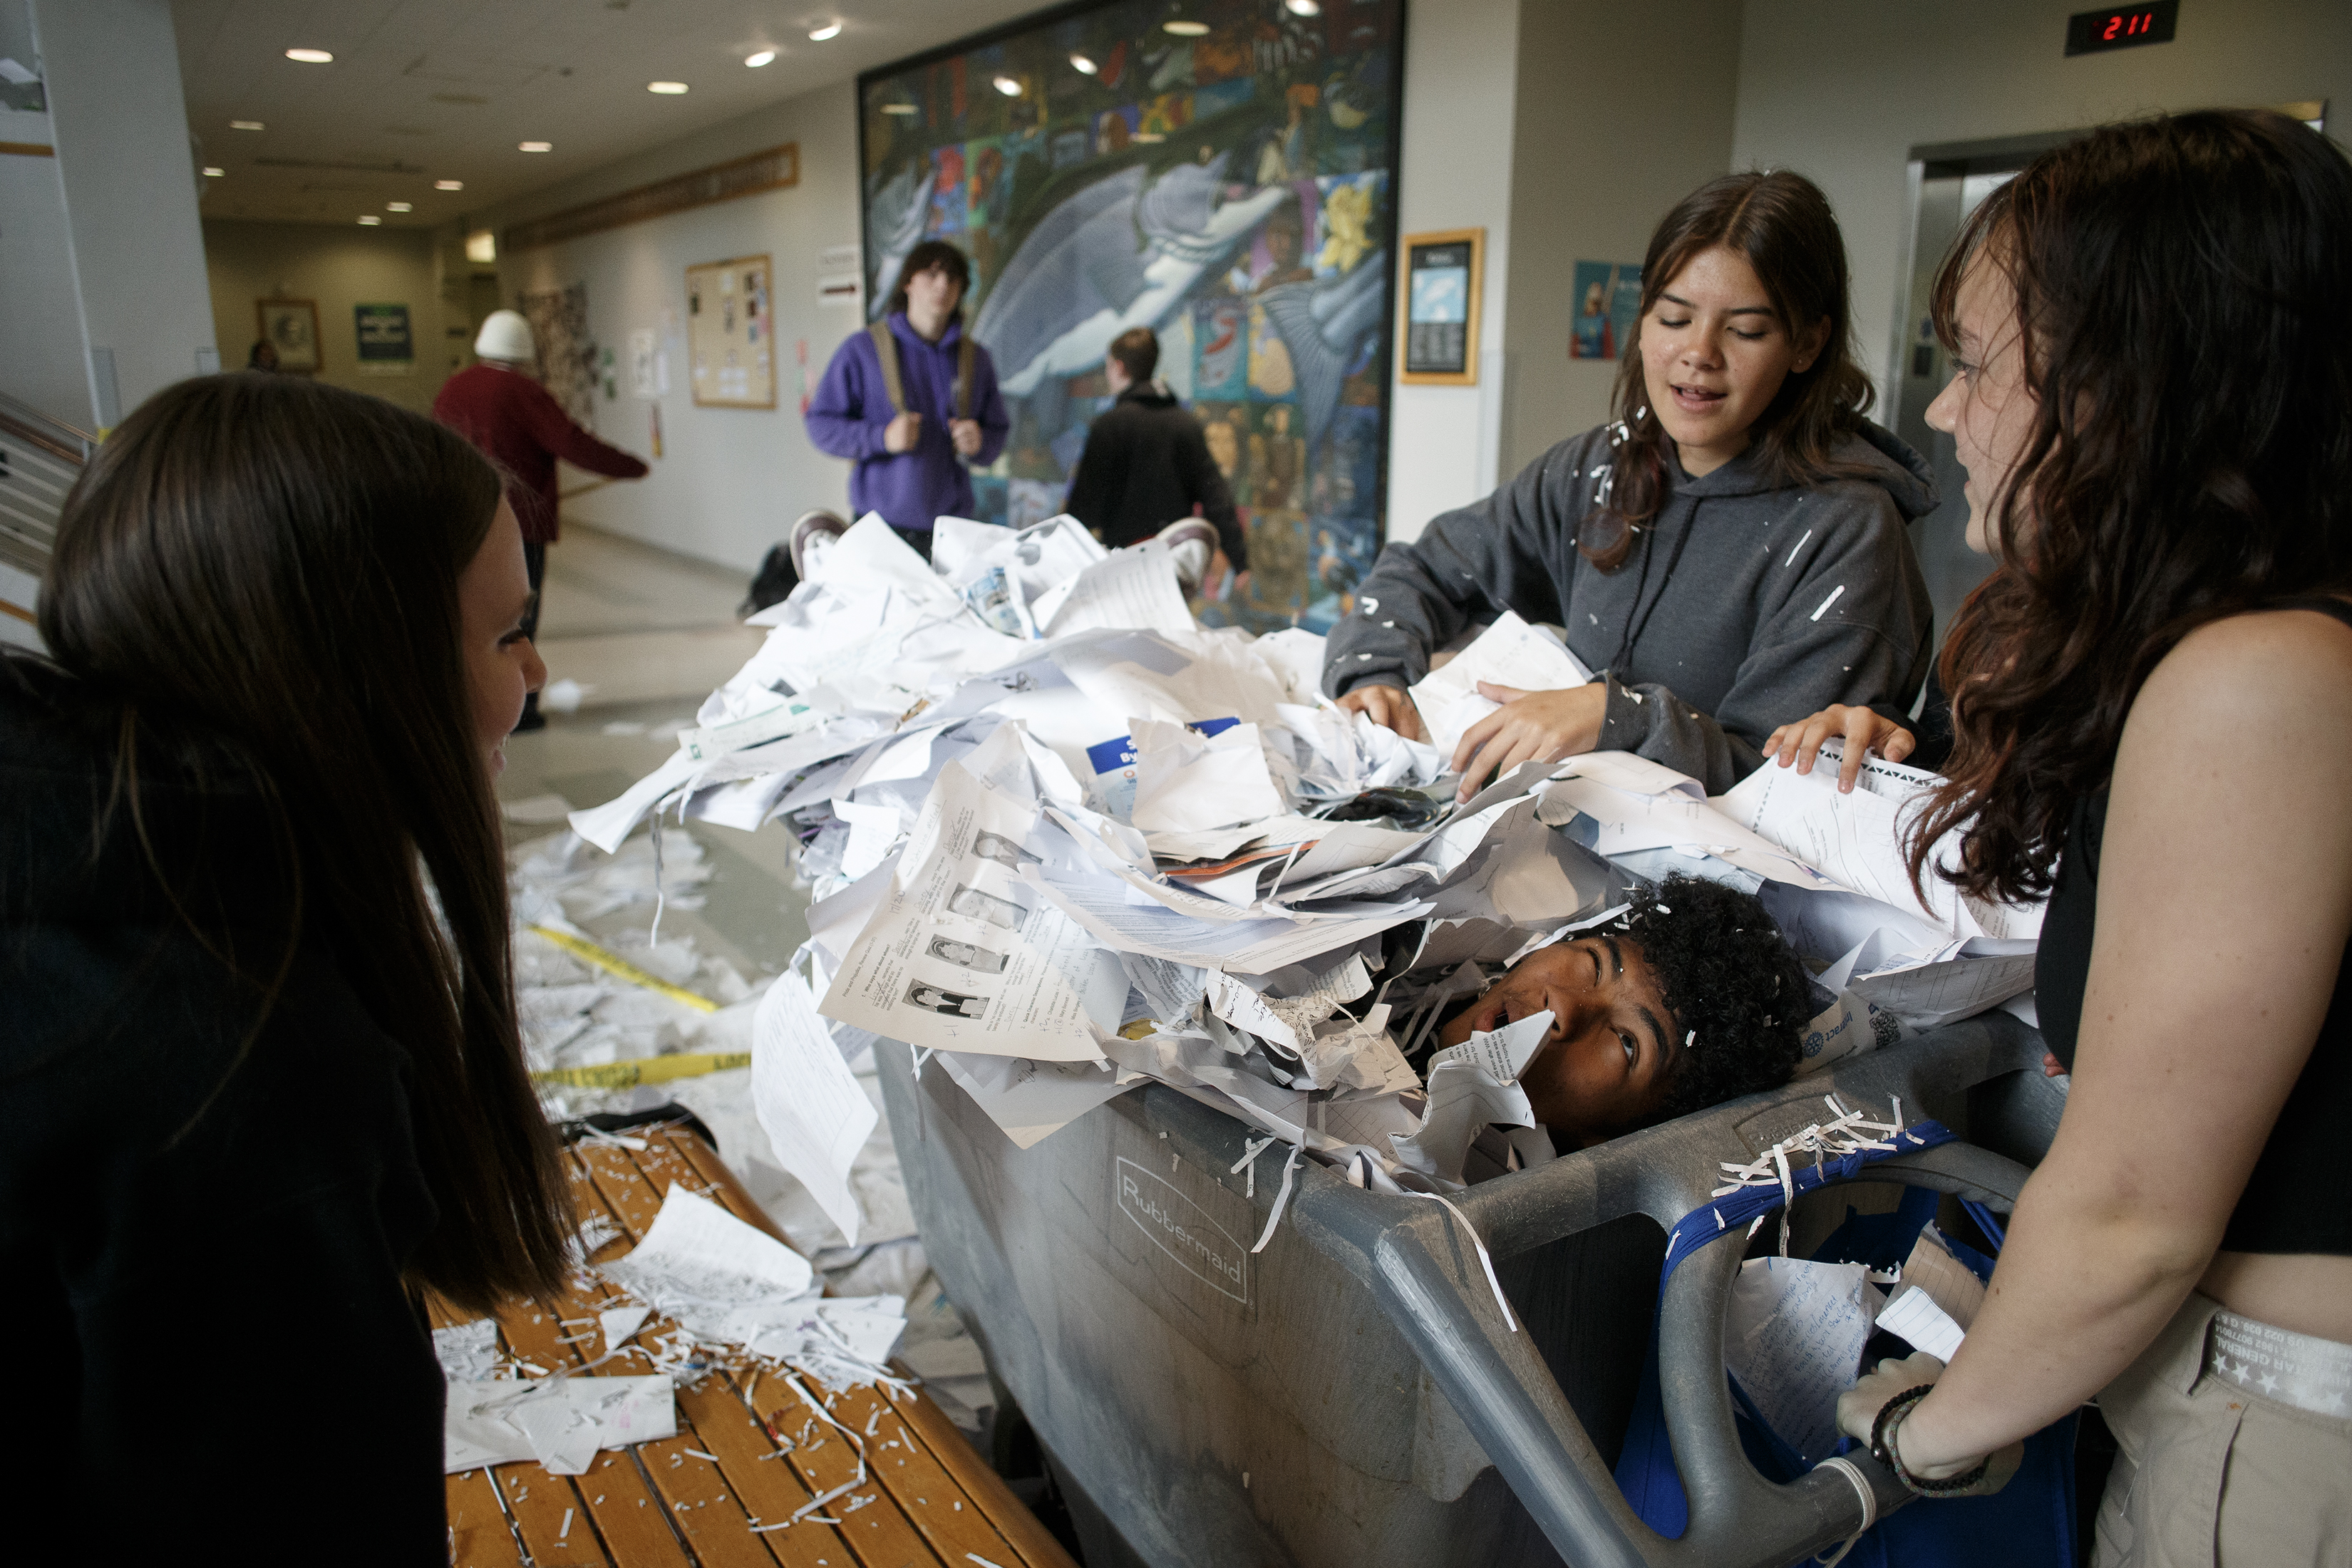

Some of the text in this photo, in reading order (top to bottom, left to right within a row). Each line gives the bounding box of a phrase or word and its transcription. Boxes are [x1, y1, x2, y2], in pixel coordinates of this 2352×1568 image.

[2103, 13, 2152, 41] 211
[934, 875, 943, 885] only
[886, 887, 909, 916] 17/20
[909, 919, 920, 934] handsome
[877, 956, 885, 966] about
[882, 943, 892, 956] whom?
[903, 947, 913, 959] enough
[1148, 956, 1160, 971] Thanks
[1160, 962, 1168, 971] can
[881, 966, 890, 979] remarks
[1142, 957, 1174, 1002] elliptical ceiling (called
[1162, 971, 1174, 984] focus
[1183, 977, 1192, 987] how
[842, 986, 850, 997] Pride
[1026, 996, 1036, 1013] Character
[1032, 976, 1045, 997] Descriptions.
[1046, 1001, 1056, 1016] Charlotte
[1051, 991, 1060, 1001] Lucas
[1061, 996, 1071, 1009] Bennett
[1072, 999, 1082, 1013] Bingley
[1058, 1008, 1066, 1018] Mary
[1069, 1011, 1078, 1021] Miss
[1822, 1010, 1856, 1043] Interact
[1500, 1043, 1510, 1058] hoping
[1505, 1058, 1513, 1073] teams
[1123, 1175, 1242, 1285] Rubbermaid
[2211, 1334, 2268, 1366] GENERAL
